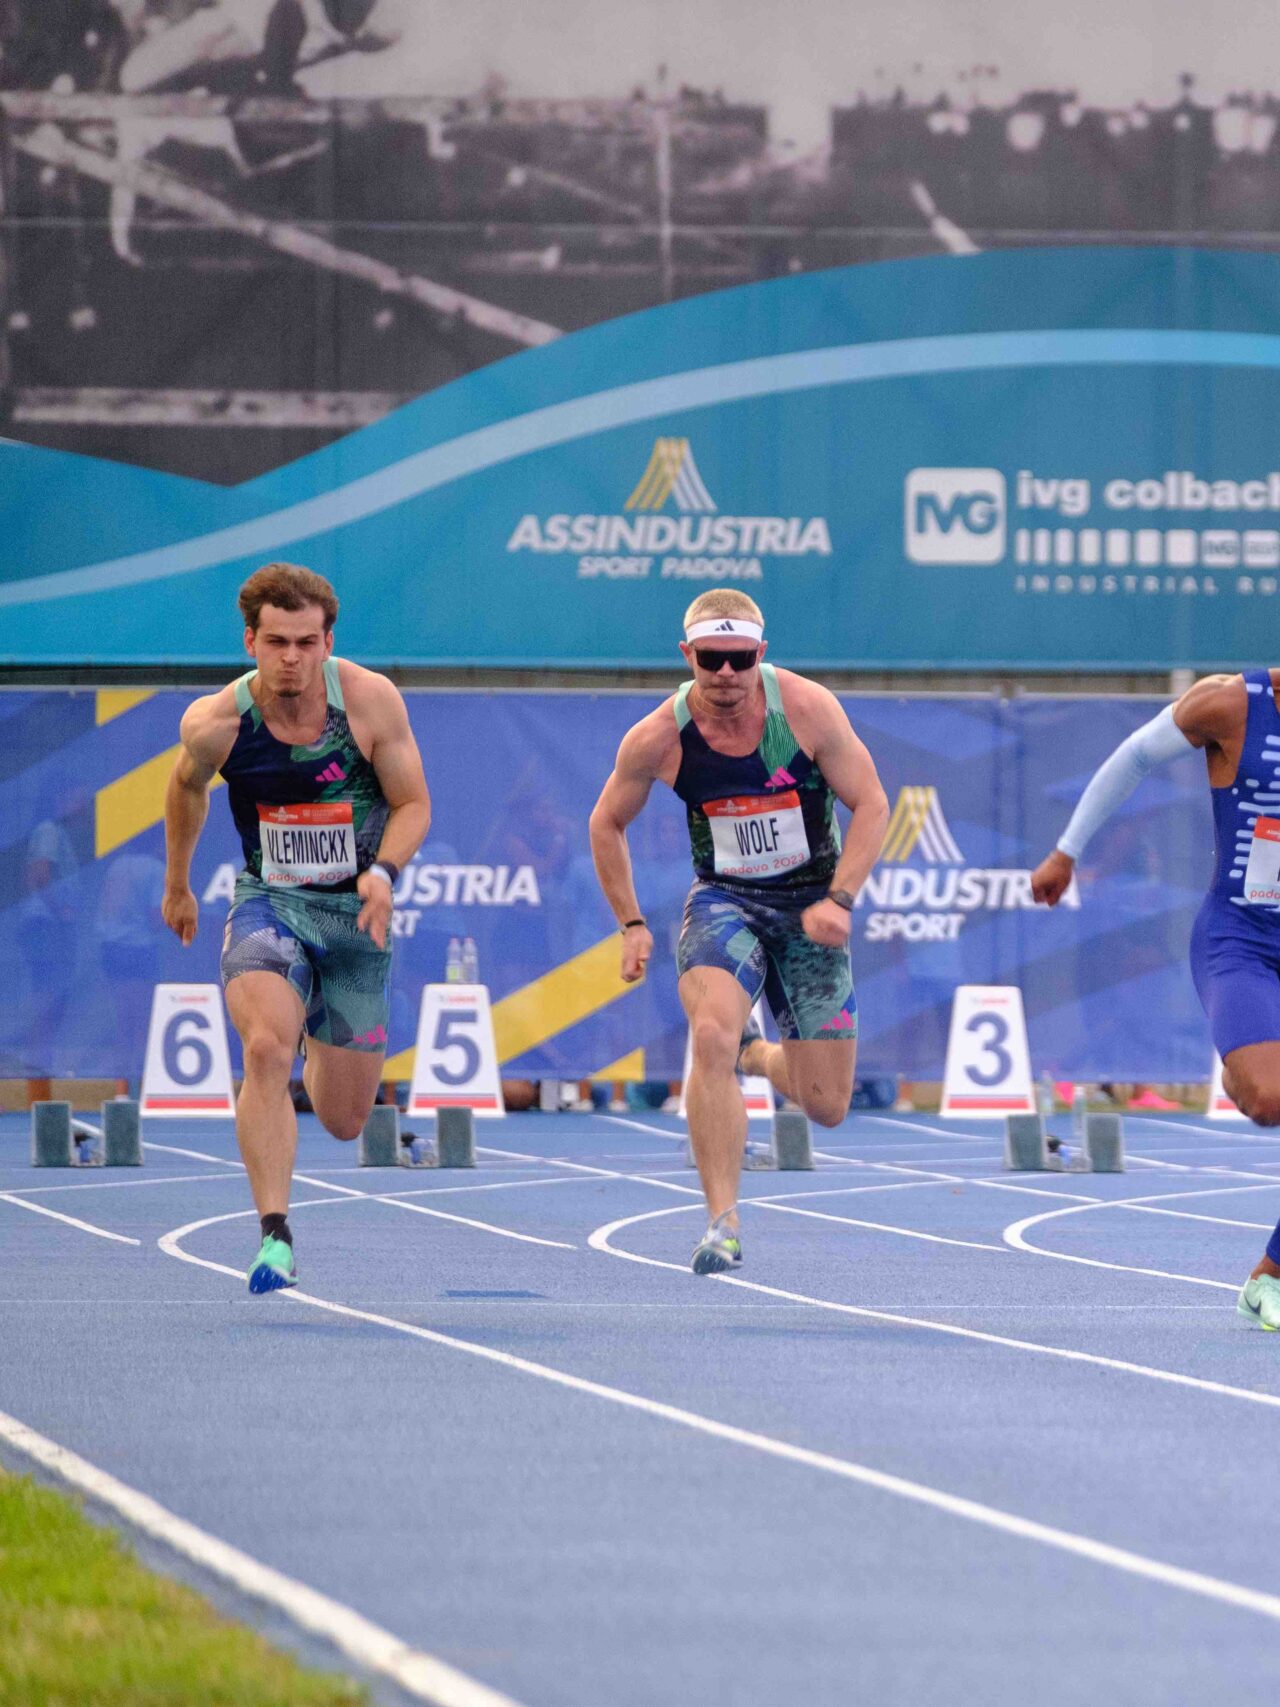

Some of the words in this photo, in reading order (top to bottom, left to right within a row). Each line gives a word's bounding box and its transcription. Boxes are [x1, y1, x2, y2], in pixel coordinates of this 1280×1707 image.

[912, 490, 998, 536] IVG
[1016, 469, 1091, 517] ivg
[506, 513, 832, 555] ASSINDUSTRIA
[577, 556, 653, 578] SPORT
[661, 558, 763, 580] PADOVA
[266, 828, 349, 864] VLEMINCKX
[734, 817, 779, 856] WOLF
[267, 872, 313, 885] padova
[854, 868, 1082, 910] NDUSTRA
[865, 912, 965, 942] SPORT
[163, 1009, 213, 1086] 6
[430, 1008, 481, 1086] 5
[964, 1011, 1013, 1087] 3
